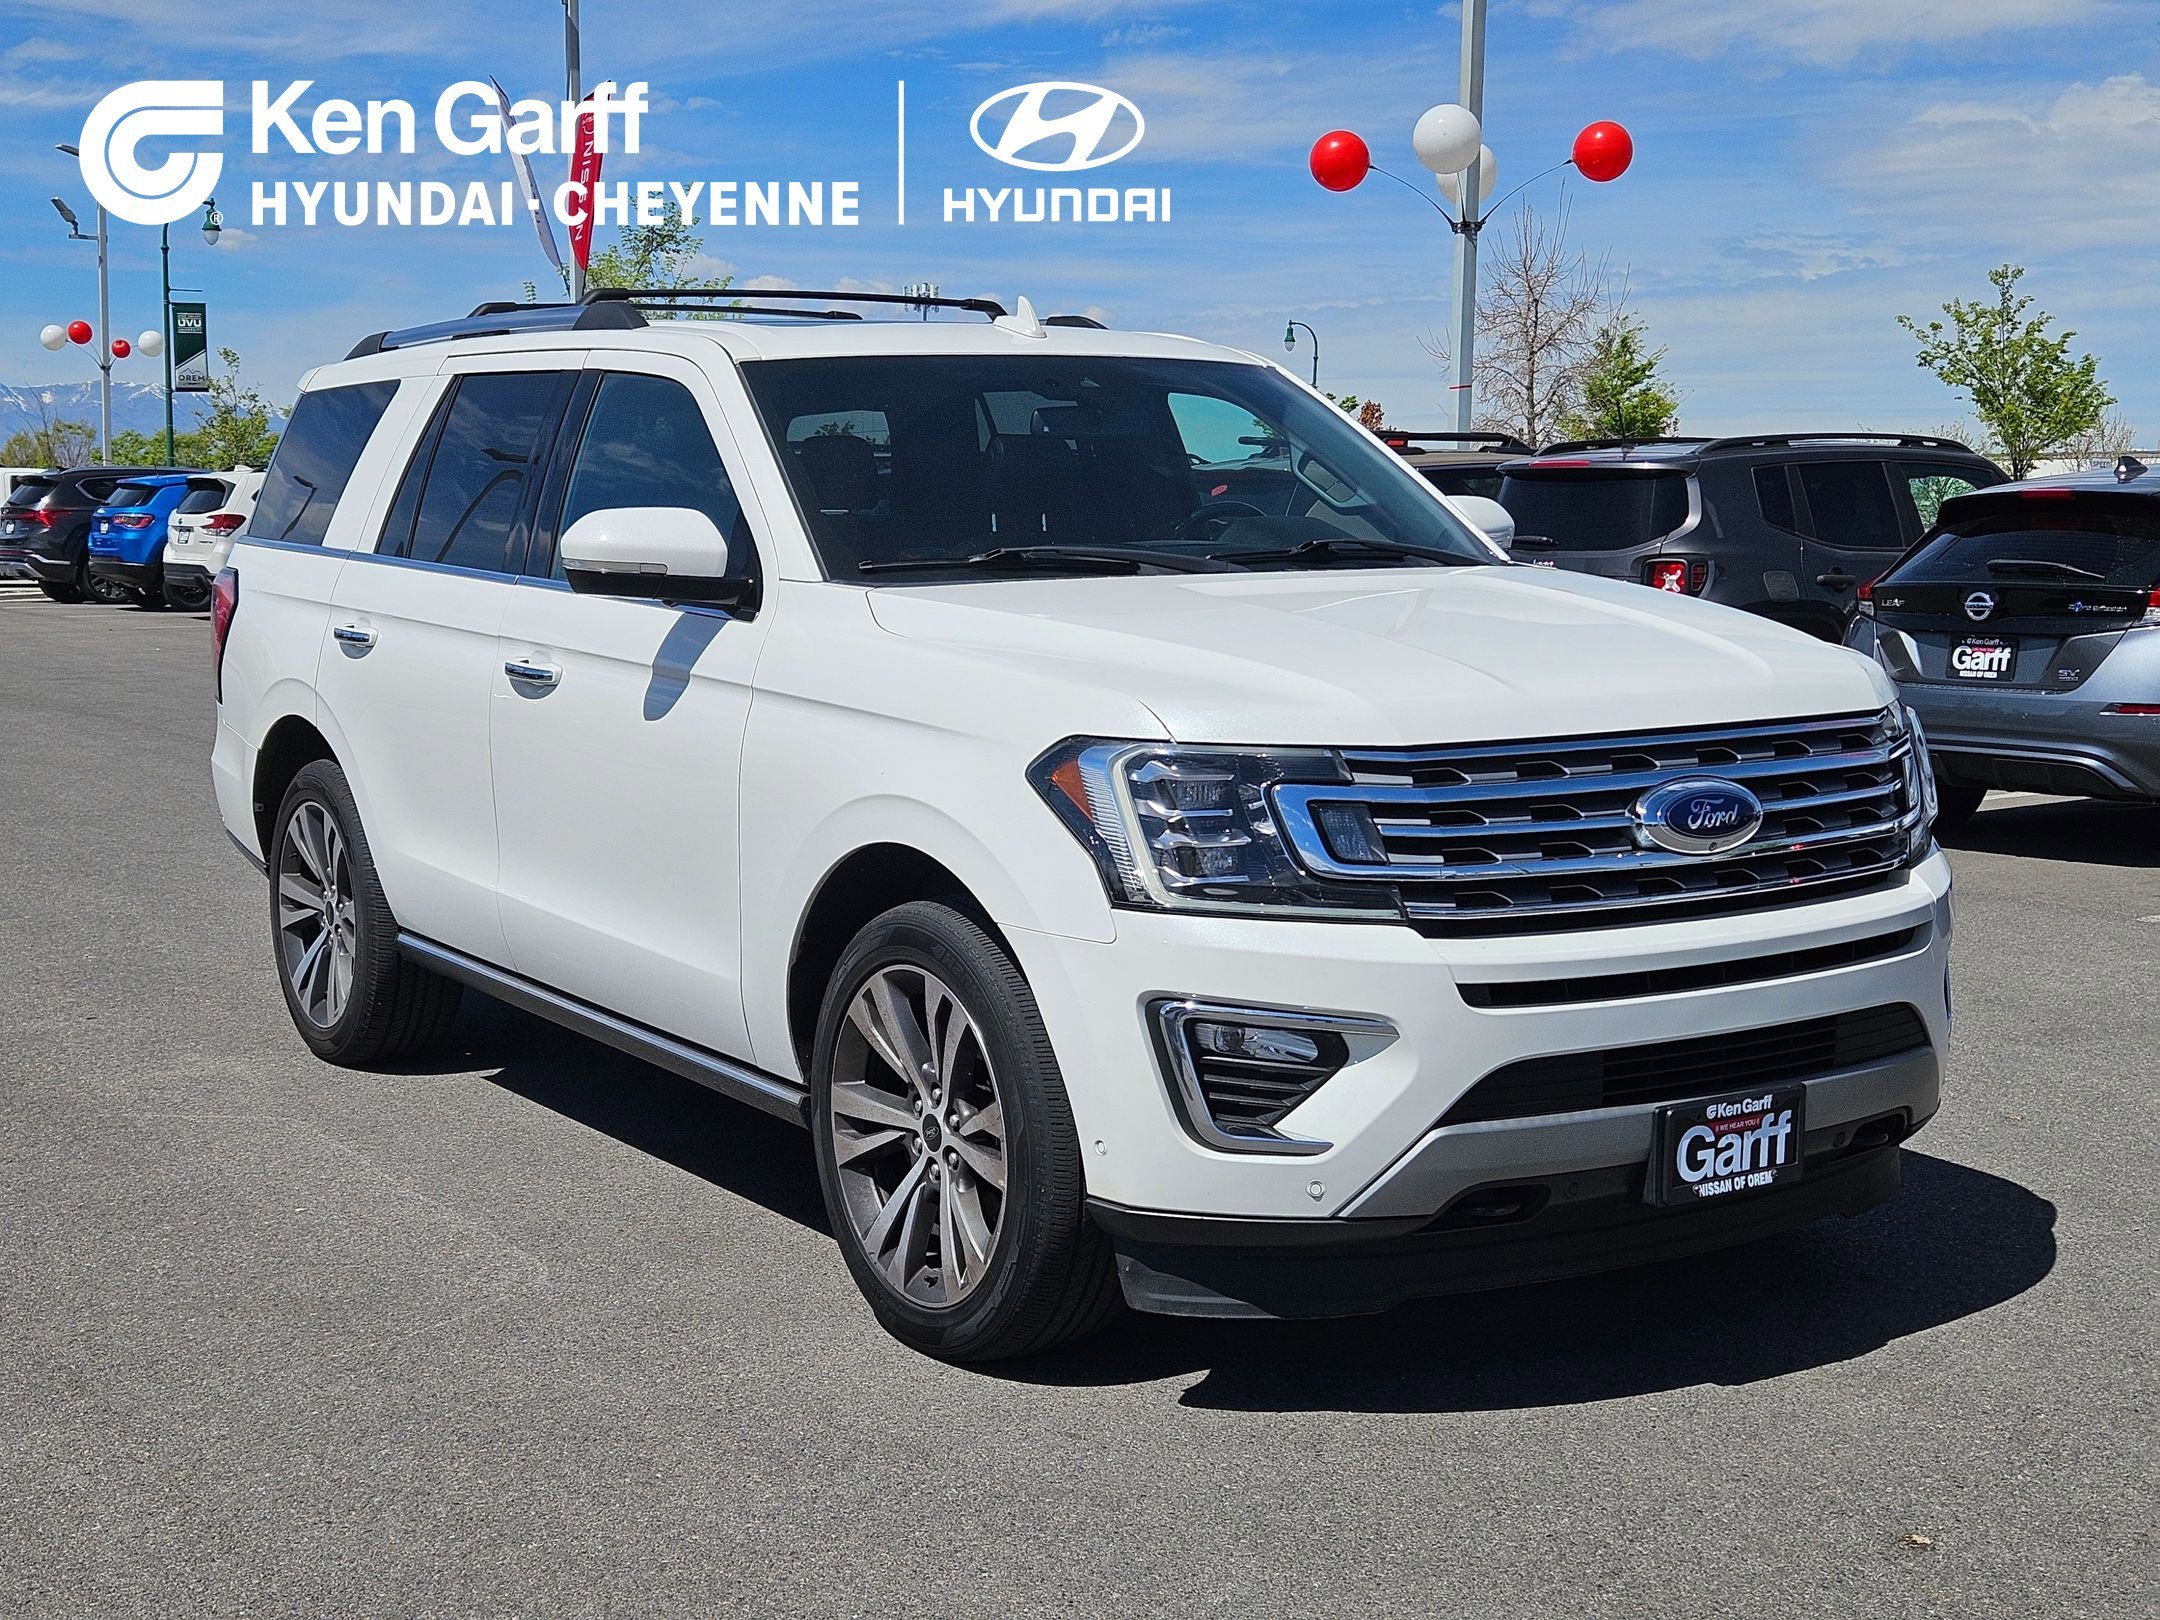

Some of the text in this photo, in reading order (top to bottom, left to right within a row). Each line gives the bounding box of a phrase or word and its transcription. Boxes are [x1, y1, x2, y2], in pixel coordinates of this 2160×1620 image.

[178, 319, 202, 327] UVU
[178, 374, 205, 382] OREM
[1881, 598, 1905, 607] LEAF
[1952, 645, 2011, 672] Garff
[1687, 798, 1739, 830] Ford
[1718, 1094, 1773, 1118] Ken Garff
[1720, 1119, 1756, 1131] WE HEAR YOU
[1676, 1110, 1792, 1183] Garff
[1699, 1170, 1773, 1198] NISSAN OF OREM
